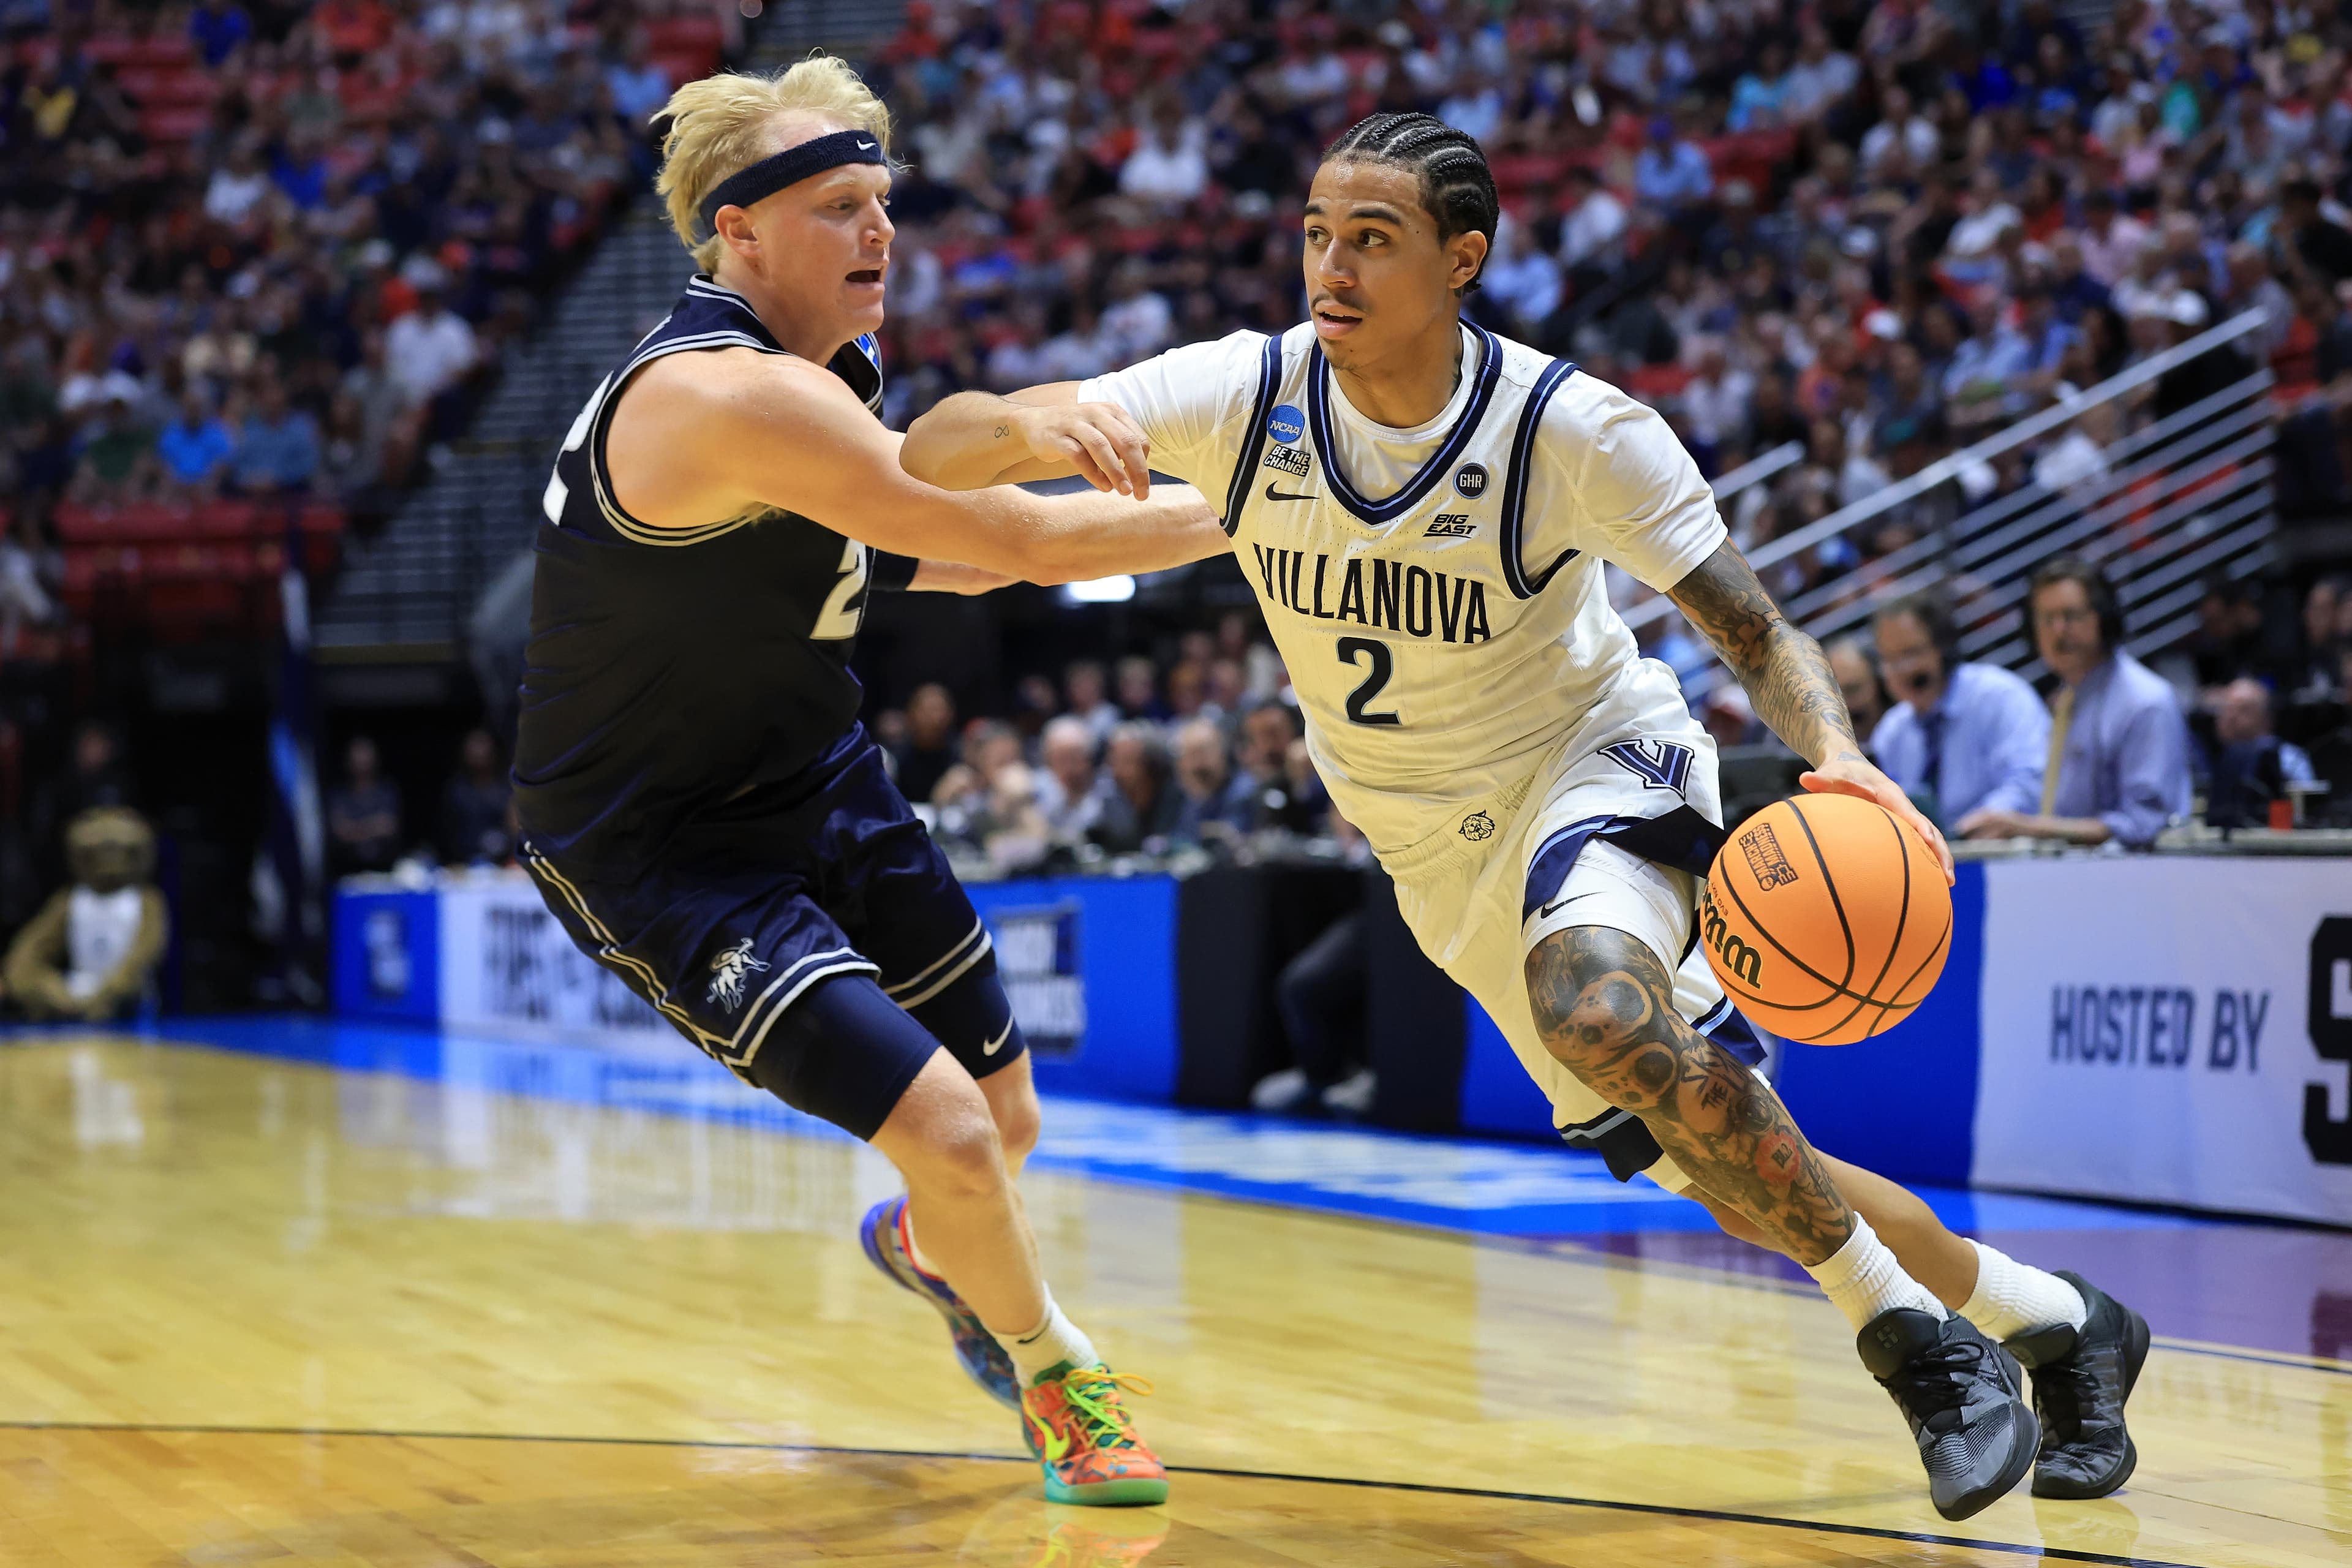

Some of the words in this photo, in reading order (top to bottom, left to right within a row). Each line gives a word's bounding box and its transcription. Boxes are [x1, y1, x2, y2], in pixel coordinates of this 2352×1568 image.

[1270, 420, 1300, 436] NCAA
[1264, 454, 1308, 476] CHANGE
[1272, 445, 1288, 458] BE
[1288, 450, 1310, 466] THE
[1460, 473, 1482, 488] GHR
[1427, 523, 1477, 535] EAST
[1433, 514, 1469, 524] BIG
[1253, 541, 1491, 644] VILLANOVA
[1335, 636, 1403, 726] 2
[1744, 843, 1773, 880] MARCH
[1717, 897, 1729, 917] EVO
[2049, 984, 2196, 1067] HOSTED
[2207, 987, 2271, 1074] BY
[1701, 1081, 1728, 1110] THE
